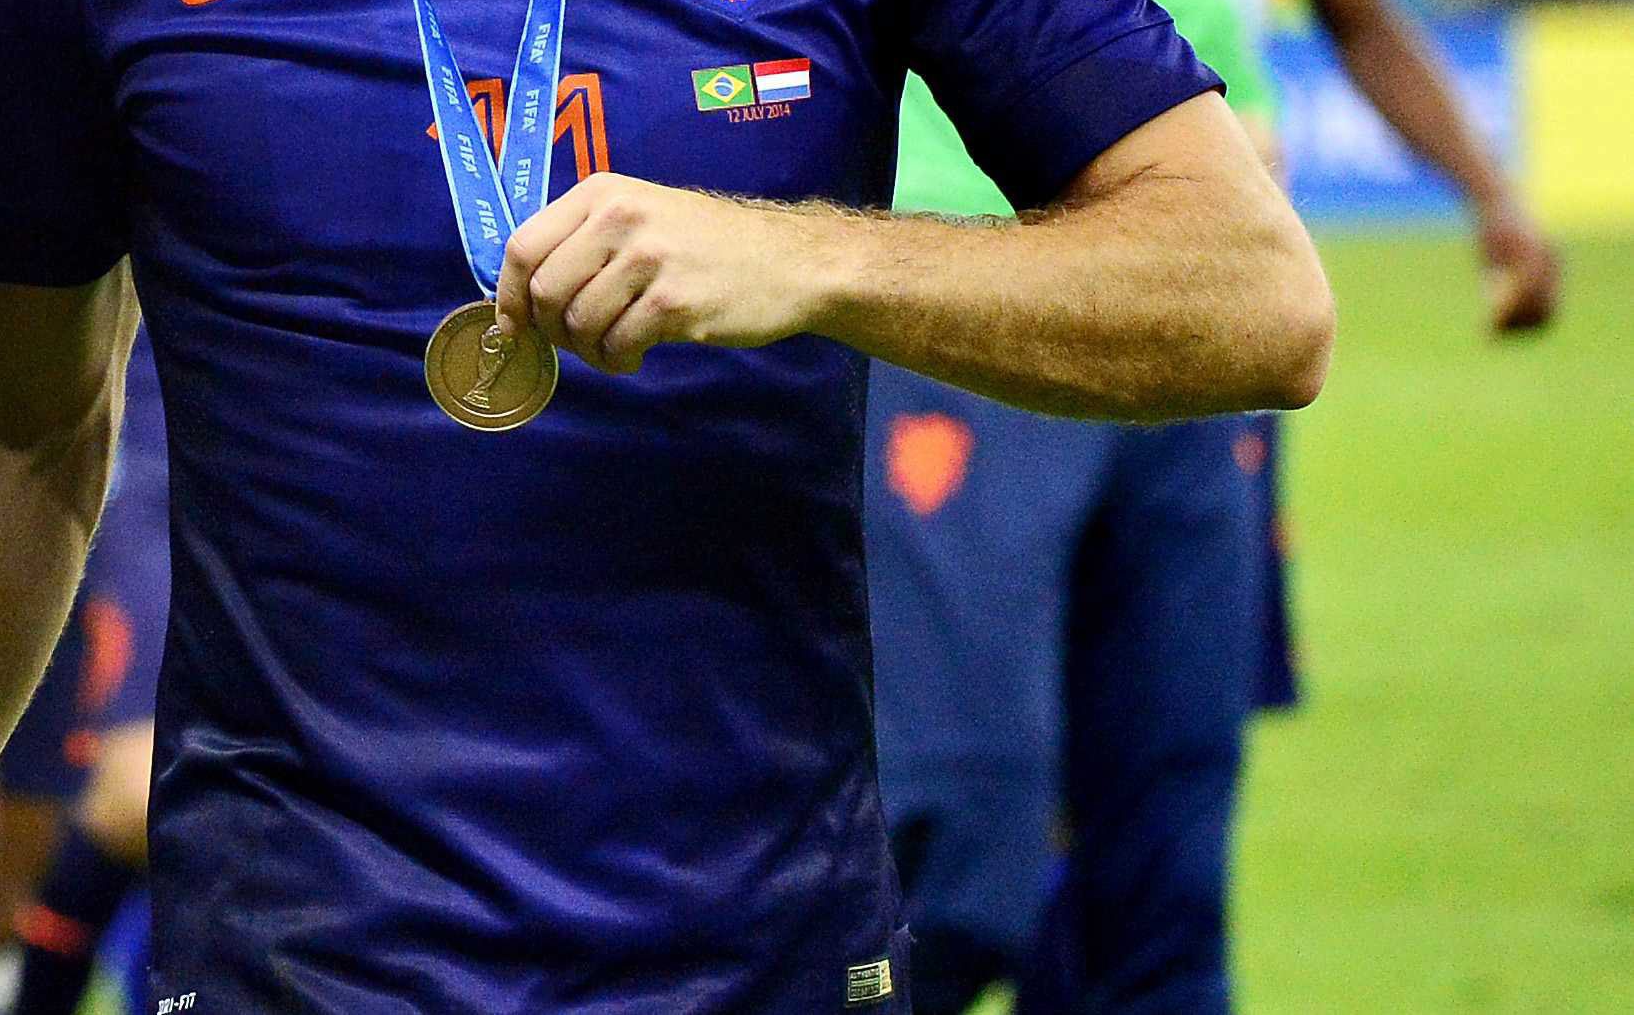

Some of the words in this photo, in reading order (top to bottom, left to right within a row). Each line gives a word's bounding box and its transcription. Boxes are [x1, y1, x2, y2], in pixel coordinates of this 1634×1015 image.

[530, 23, 551, 64] FIFA
[440, 66, 460, 105] FIFA
[522, 89, 540, 131] FIFA
[727, 109, 740, 123] 12
[743, 106, 764, 122] JULY
[765, 103, 791, 119] 2014
[458, 133, 478, 178] FIFA
[513, 158, 532, 199] FIFA
[476, 198, 499, 240] FIFA
